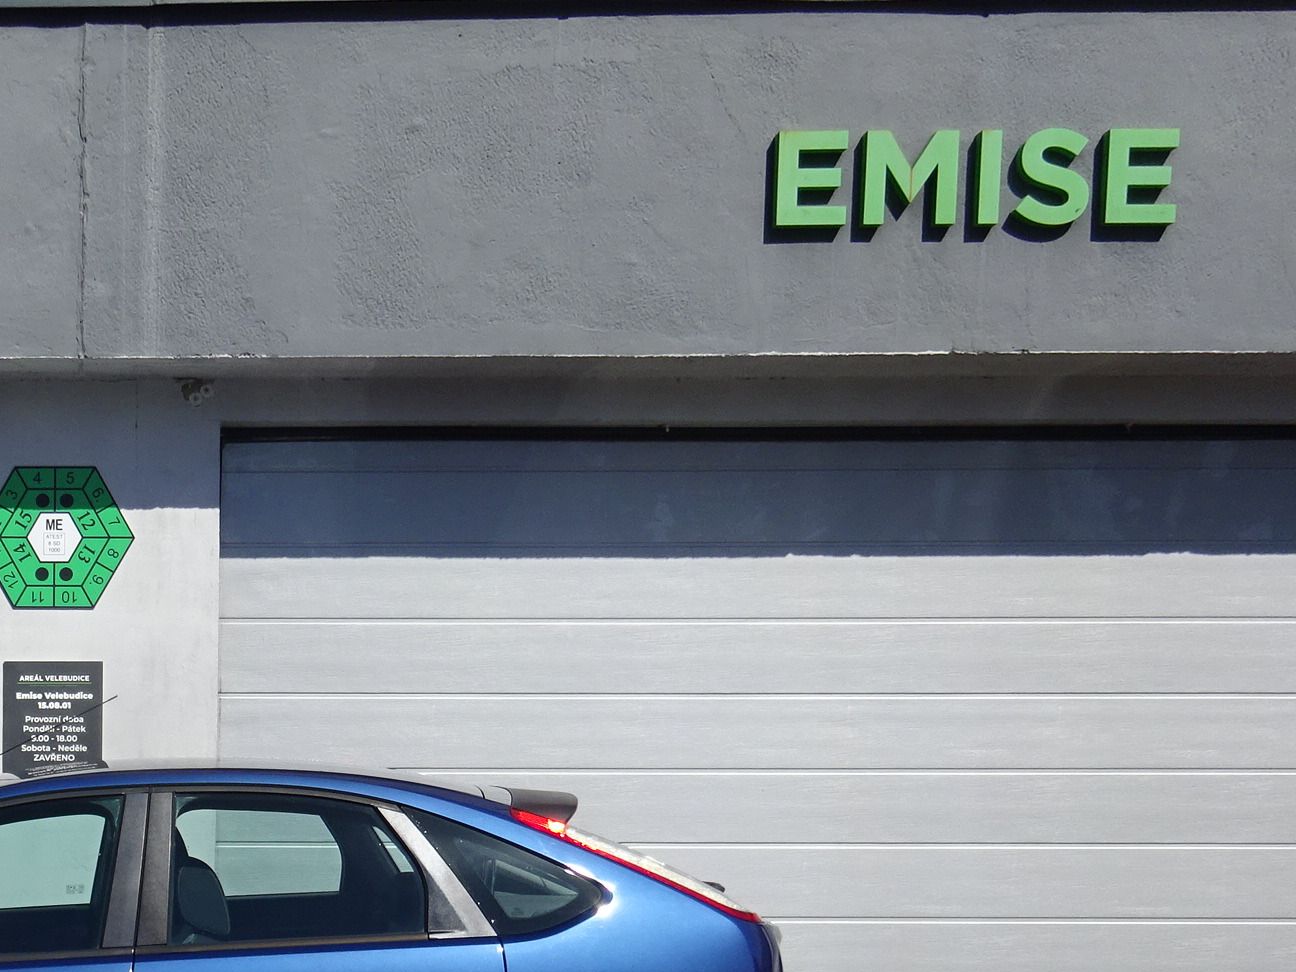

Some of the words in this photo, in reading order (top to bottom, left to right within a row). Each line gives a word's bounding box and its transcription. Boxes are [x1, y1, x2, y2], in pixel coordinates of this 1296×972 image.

[773, 127, 1181, 228] EMISE
[33, 471, 42, 484] 4
[66, 471, 75, 484] 5
[5, 489, 18, 500] 3
[14, 510, 32, 531] 15
[45, 518, 63, 531] ME
[77, 511, 96, 531] 12
[108, 517, 121, 526] 7
[13, 542, 32, 563] 14
[78, 544, 96, 564] 13
[107, 548, 120, 559] 8
[4, 570, 19, 589] 12
[31, 591, 45, 603] 11
[61, 591, 77, 603] 10
[19, 674, 44, 682] AREÁL
[45, 674, 90, 682] VELEBUDICE
[16, 691, 43, 700] Emise
[44, 691, 94, 700] Velebudice
[25, 715, 62, 723] Provozní
[61, 725, 86, 733] Pátek
[56, 734, 78, 742] 18.00
[21, 744, 51, 752] Sobota
[57, 744, 88, 752] Neděle
[33, 753, 76, 762] ZAVŘENO
